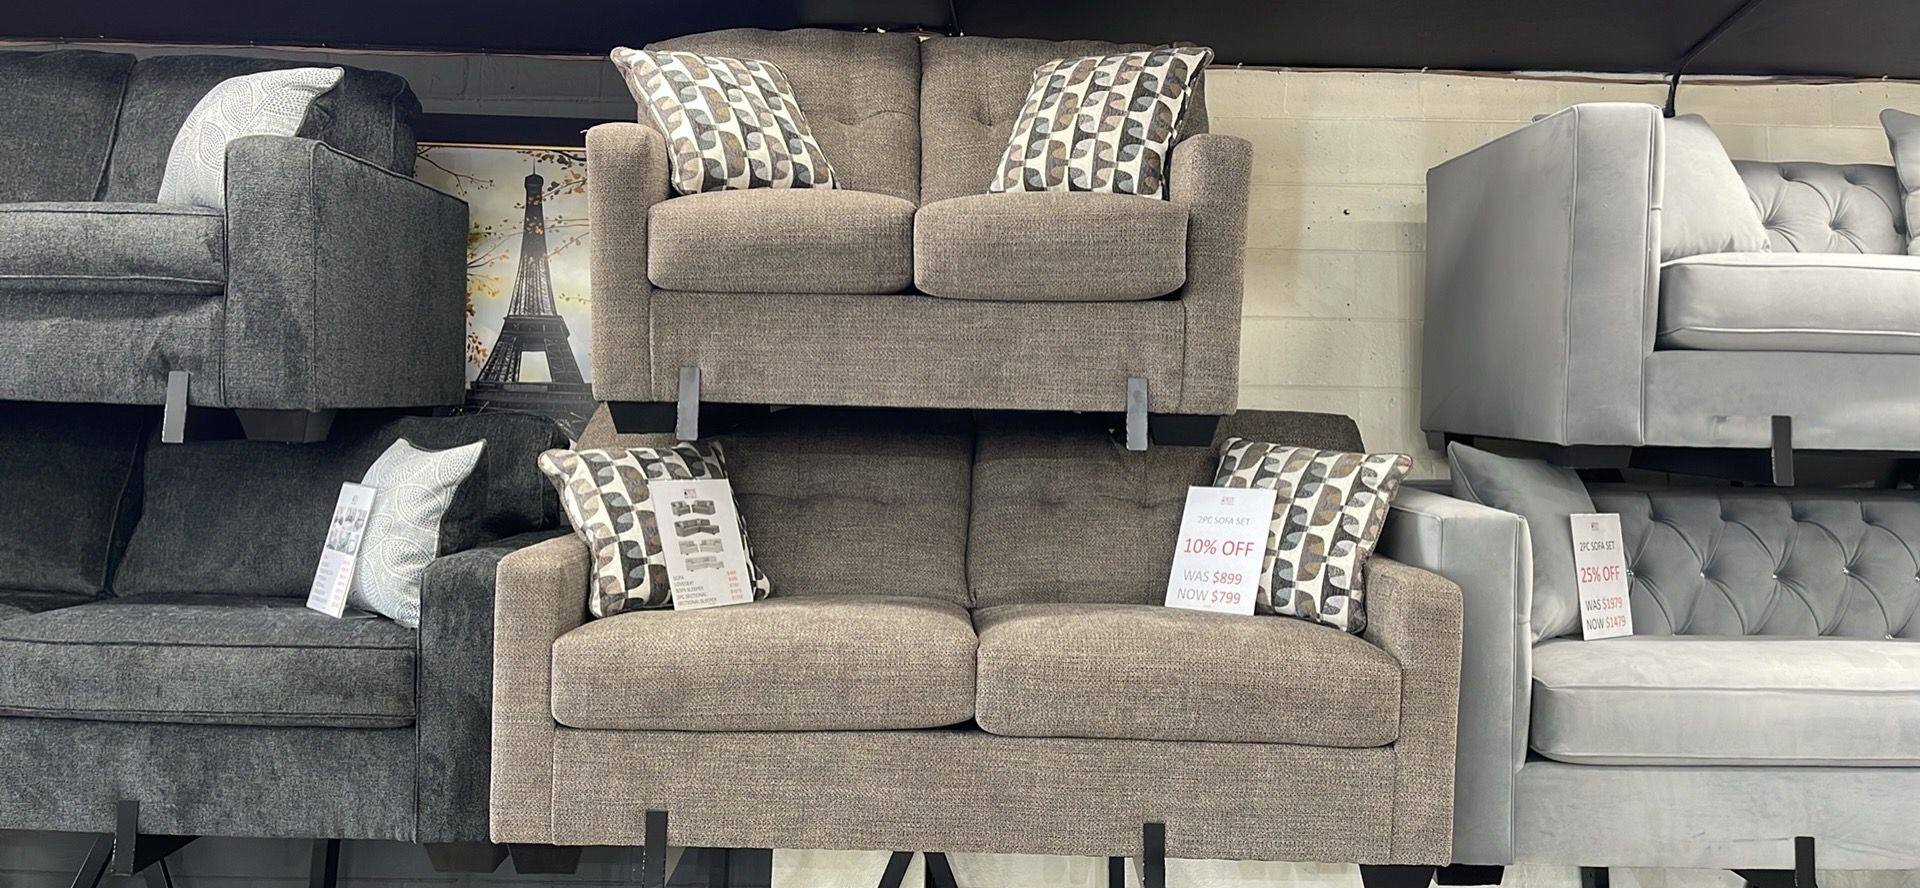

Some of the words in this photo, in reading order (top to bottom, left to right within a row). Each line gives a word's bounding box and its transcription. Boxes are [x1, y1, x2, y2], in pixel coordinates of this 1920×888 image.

[1198, 515, 1214, 524] 2PC
[1214, 516, 1234, 525] SOFA
[1235, 517, 1251, 526] SET
[1183, 538, 1217, 555] 10%
[1222, 540, 1255, 557] OFF
[1579, 542, 1590, 551] 2PC
[1590, 541, 1605, 551] SOFA
[1605, 541, 1615, 550] SET
[1183, 569, 1210, 582] WAS
[1212, 571, 1243, 585] $899
[1581, 566, 1601, 583] 25%
[1602, 565, 1620, 581] OFF
[1177, 587, 1209, 601] NOW
[1211, 590, 1241, 605] $799
[1585, 599, 1601, 611] WAS
[1602, 597, 1623, 610] $1979
[1586, 618, 1604, 630] NOW
[1605, 615, 1626, 629] $1479
